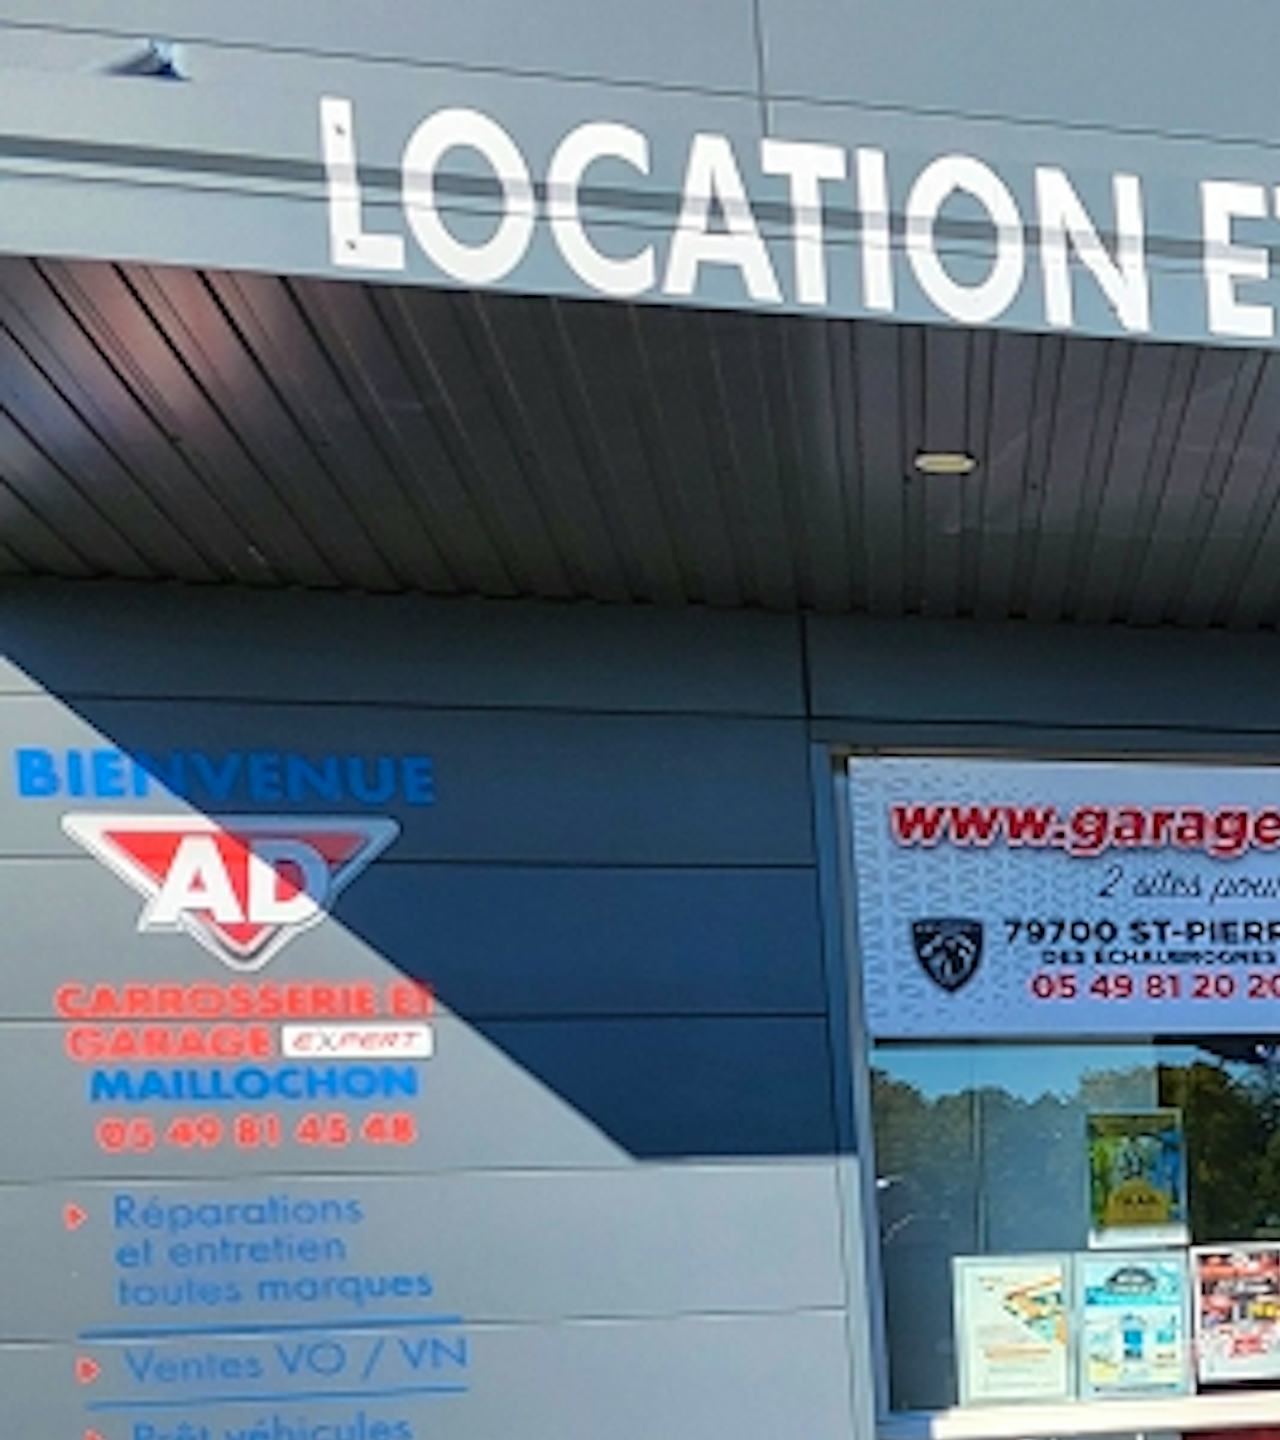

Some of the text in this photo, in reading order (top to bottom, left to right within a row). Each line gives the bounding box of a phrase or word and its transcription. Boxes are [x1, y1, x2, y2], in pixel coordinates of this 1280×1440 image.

[319, 96, 1151, 333] LOCATION
[16, 748, 435, 804] BIENVENUE
[138, 834, 331, 930] AD
[1097, 863, 1124, 898] 2
[1003, 919, 1118, 945] 79700
[56, 981, 433, 1019] CARROSSERIE ET
[1033, 973, 1076, 999] 05
[1089, 974, 1134, 998] 49
[1146, 974, 1181, 998] 81
[1192, 974, 1236, 998] 20
[67, 1026, 271, 1060] GARAGE
[90, 1068, 419, 1102] MAILLOCHON
[98, 1113, 417, 1152] 05 49 81 45 48
[114, 1193, 364, 1235] Réparations
[115, 1234, 347, 1269] et entretien
[118, 1271, 433, 1309] toutes marques
[124, 1347, 263, 1382] Ventes
[276, 1344, 347, 1376] VO
[398, 1337, 468, 1369] VN
